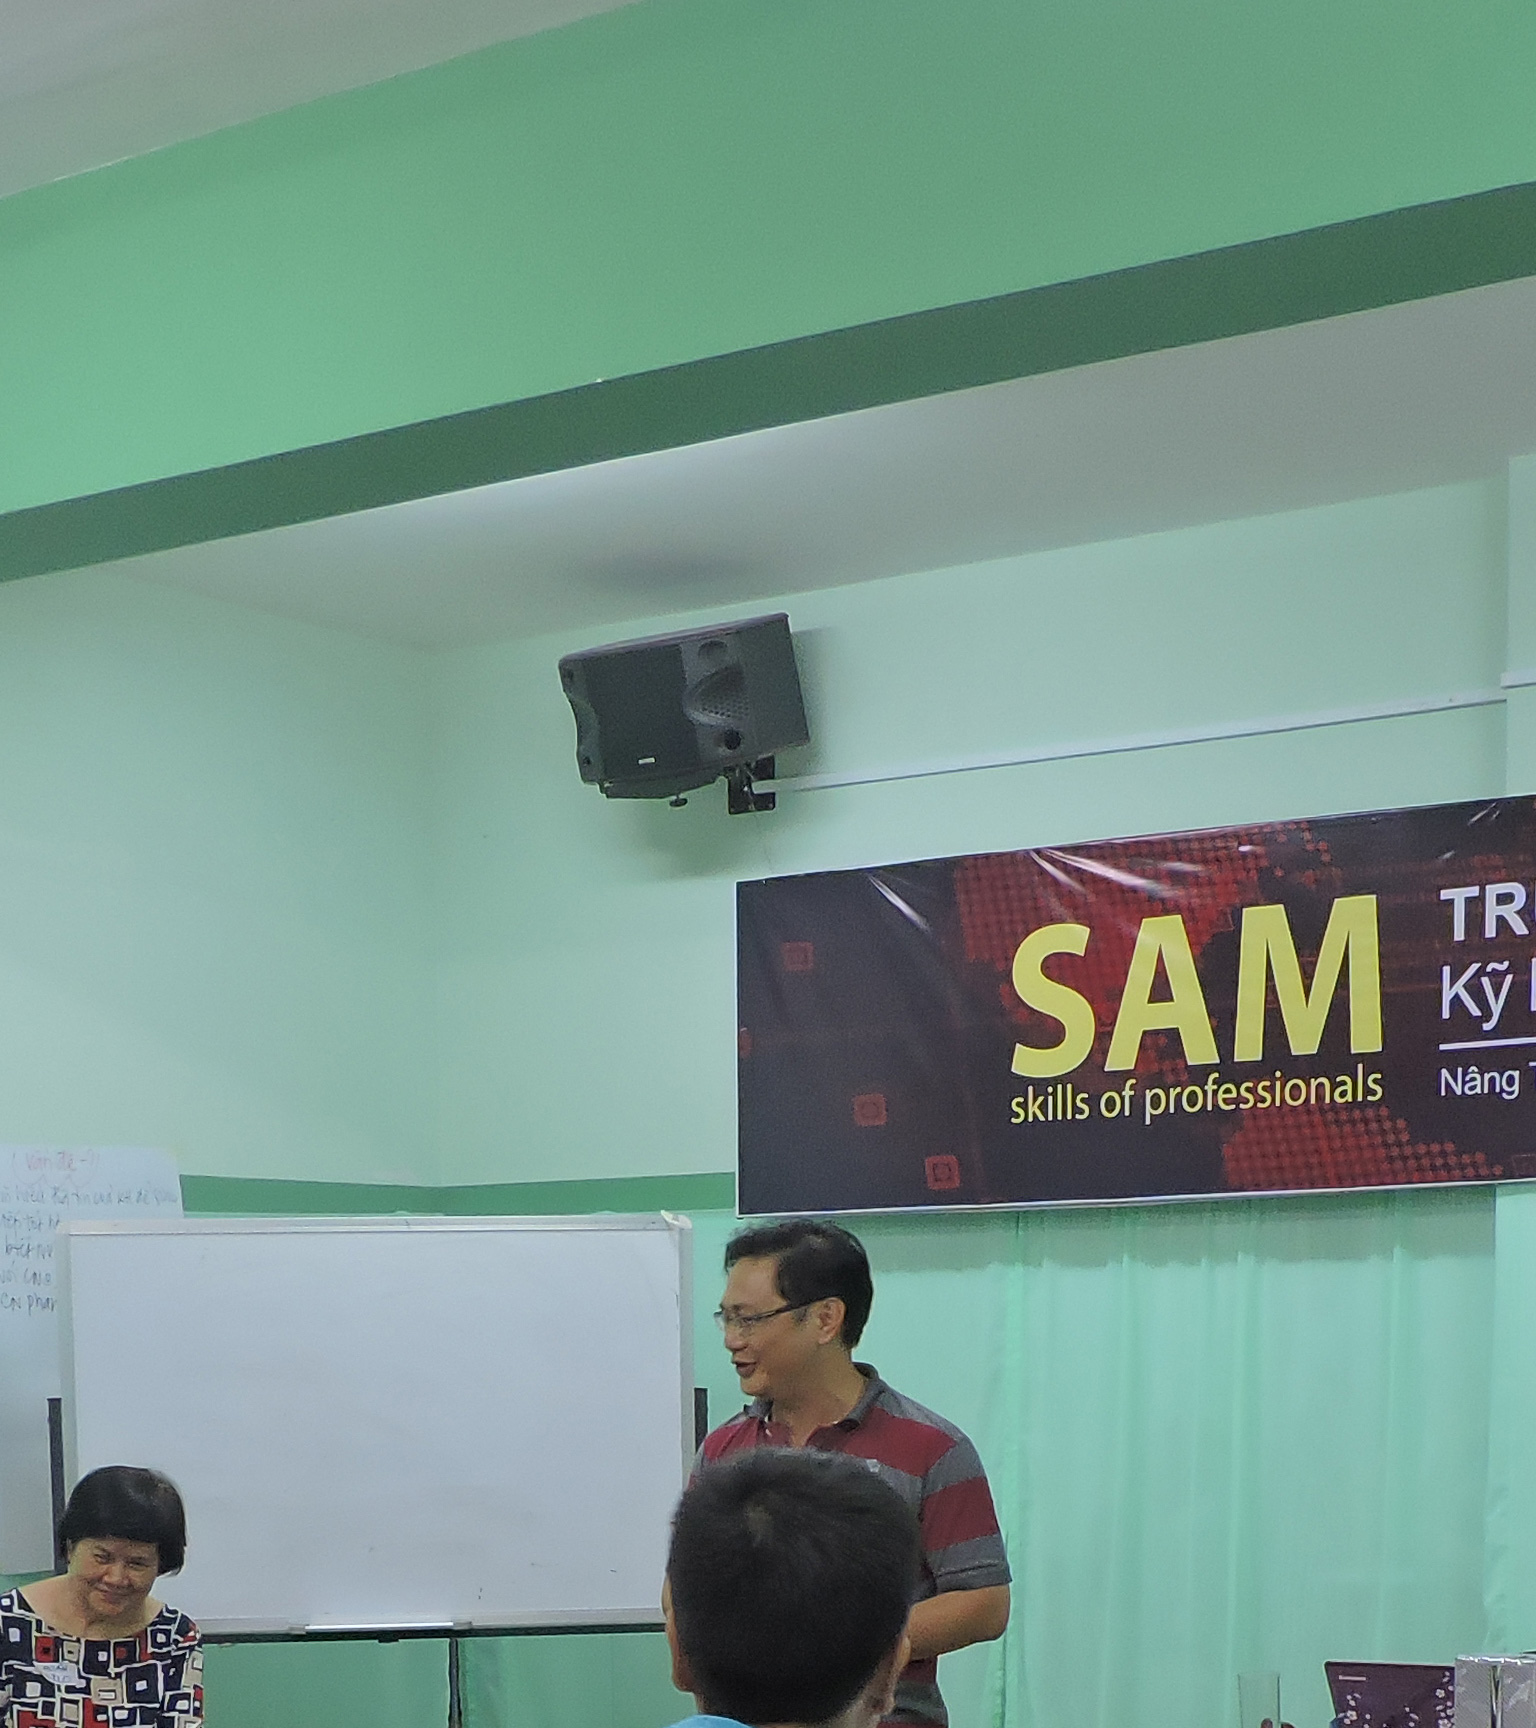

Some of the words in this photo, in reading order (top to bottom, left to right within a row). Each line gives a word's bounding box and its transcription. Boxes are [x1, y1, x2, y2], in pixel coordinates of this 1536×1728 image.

[1010, 894, 1383, 1079] SAM
[1440, 960, 1514, 1031] Kỹ
[1010, 1082, 1091, 1125] skills
[1099, 1078, 1137, 1117] of
[1144, 1063, 1384, 1126] professionals
[1439, 1065, 1521, 1100] Nâng
